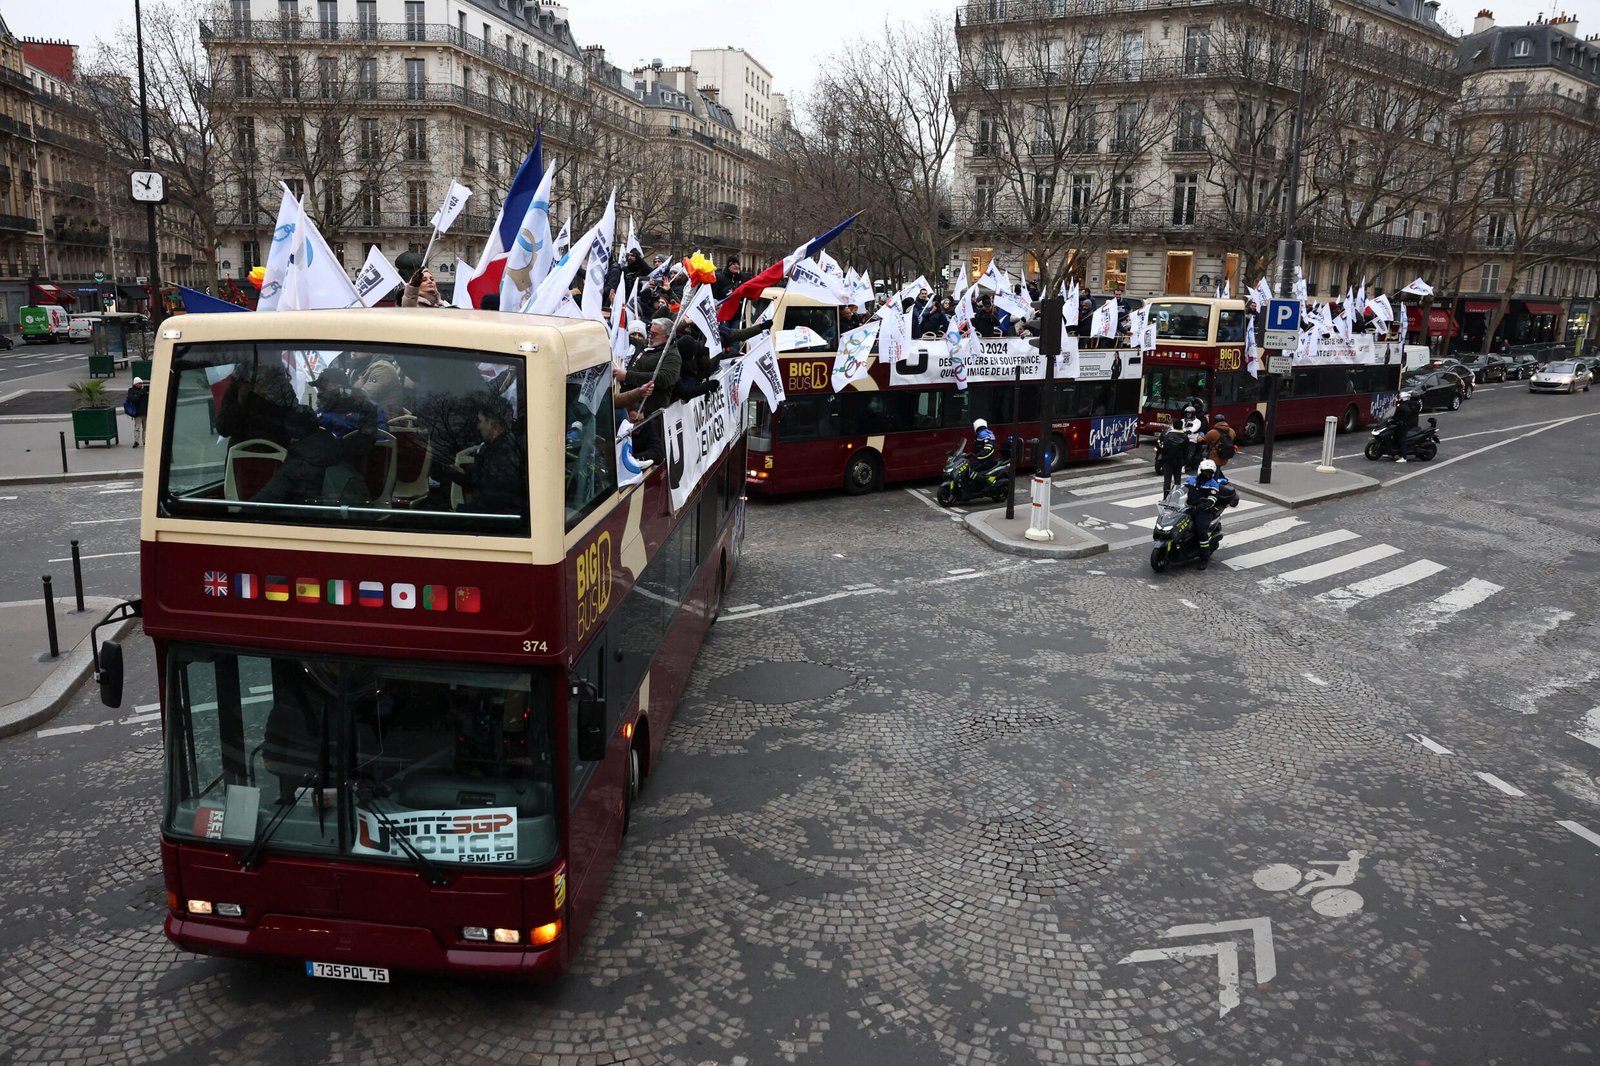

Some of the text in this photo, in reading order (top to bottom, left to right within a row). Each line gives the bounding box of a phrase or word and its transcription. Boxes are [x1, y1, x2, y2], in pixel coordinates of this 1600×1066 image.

[1277, 306, 1292, 325] P
[986, 342, 1008, 354] 2024
[1220, 349, 1232, 360] BIG
[938, 358, 952, 367] DES
[990, 356, 998, 365] EN
[1219, 360, 1232, 370] BUS
[790, 362, 811, 377] BIG
[990, 367, 1000, 376] DE
[1002, 367, 1010, 375] LA
[789, 377, 810, 390] BUS
[1089, 418, 1123, 449] Galeries
[1100, 418, 1138, 456] Lafayette
[576, 542, 598, 601] BIG
[578, 586, 598, 642] BUS
[522, 640, 548, 652] 374
[391, 833, 514, 855] POLICE
[459, 852, 514, 862] FSMI-FO
[369, 969, 385, 981] 75
